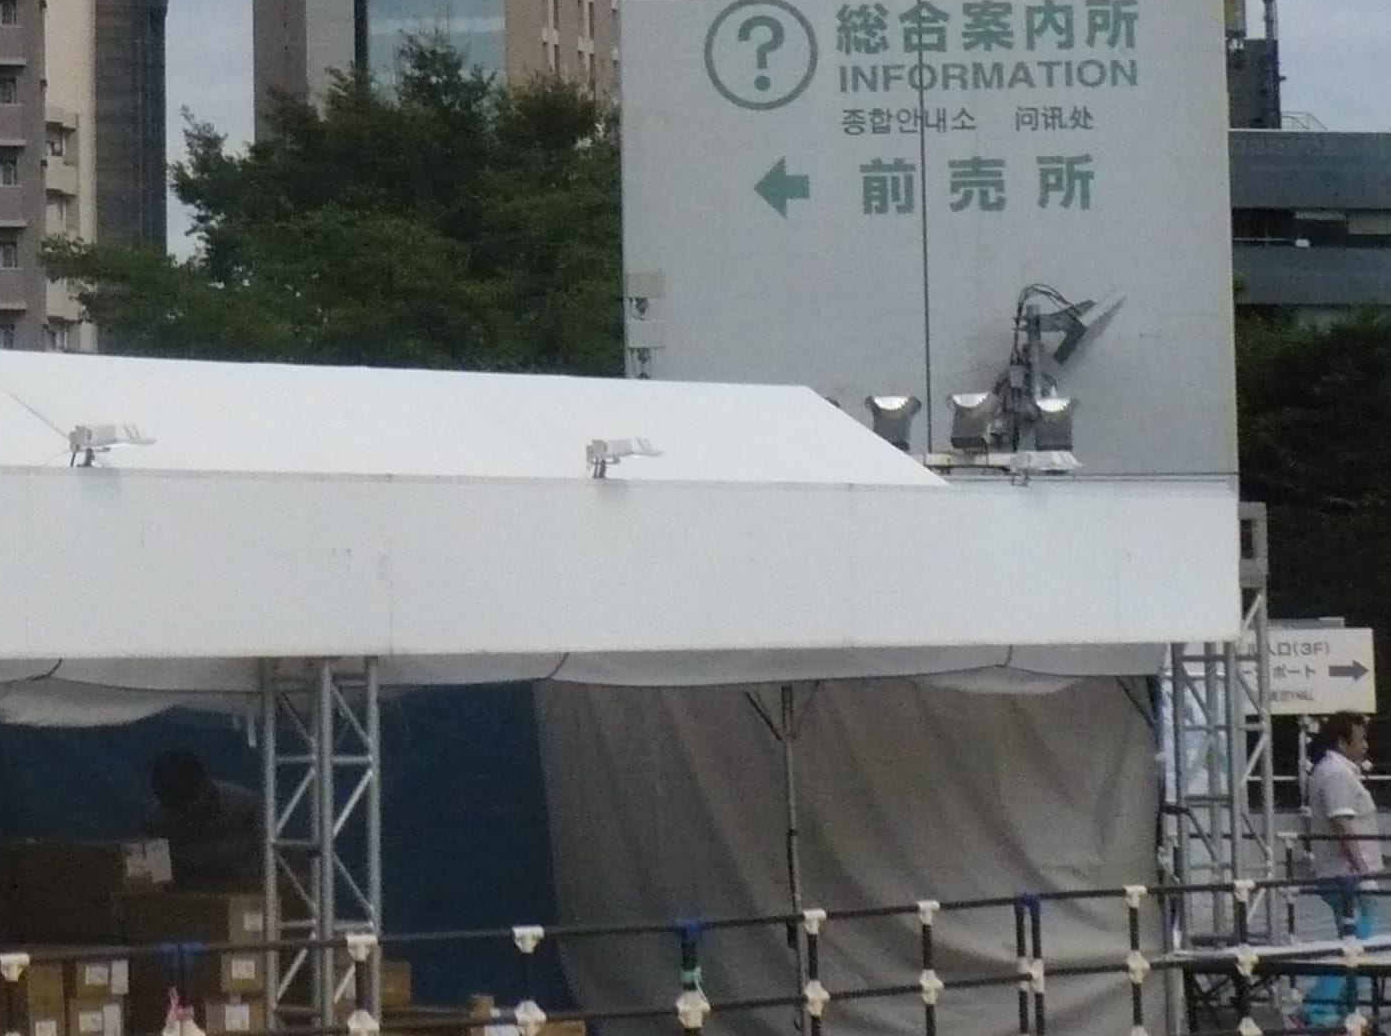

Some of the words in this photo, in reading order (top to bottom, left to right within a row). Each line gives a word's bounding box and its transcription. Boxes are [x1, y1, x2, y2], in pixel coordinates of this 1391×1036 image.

[838, 59, 1138, 94] INFORMATION
[841, 108, 977, 136] 종합안내소
[1014, 105, 1095, 132] 问讯处
[859, 153, 1097, 215] 前売所
